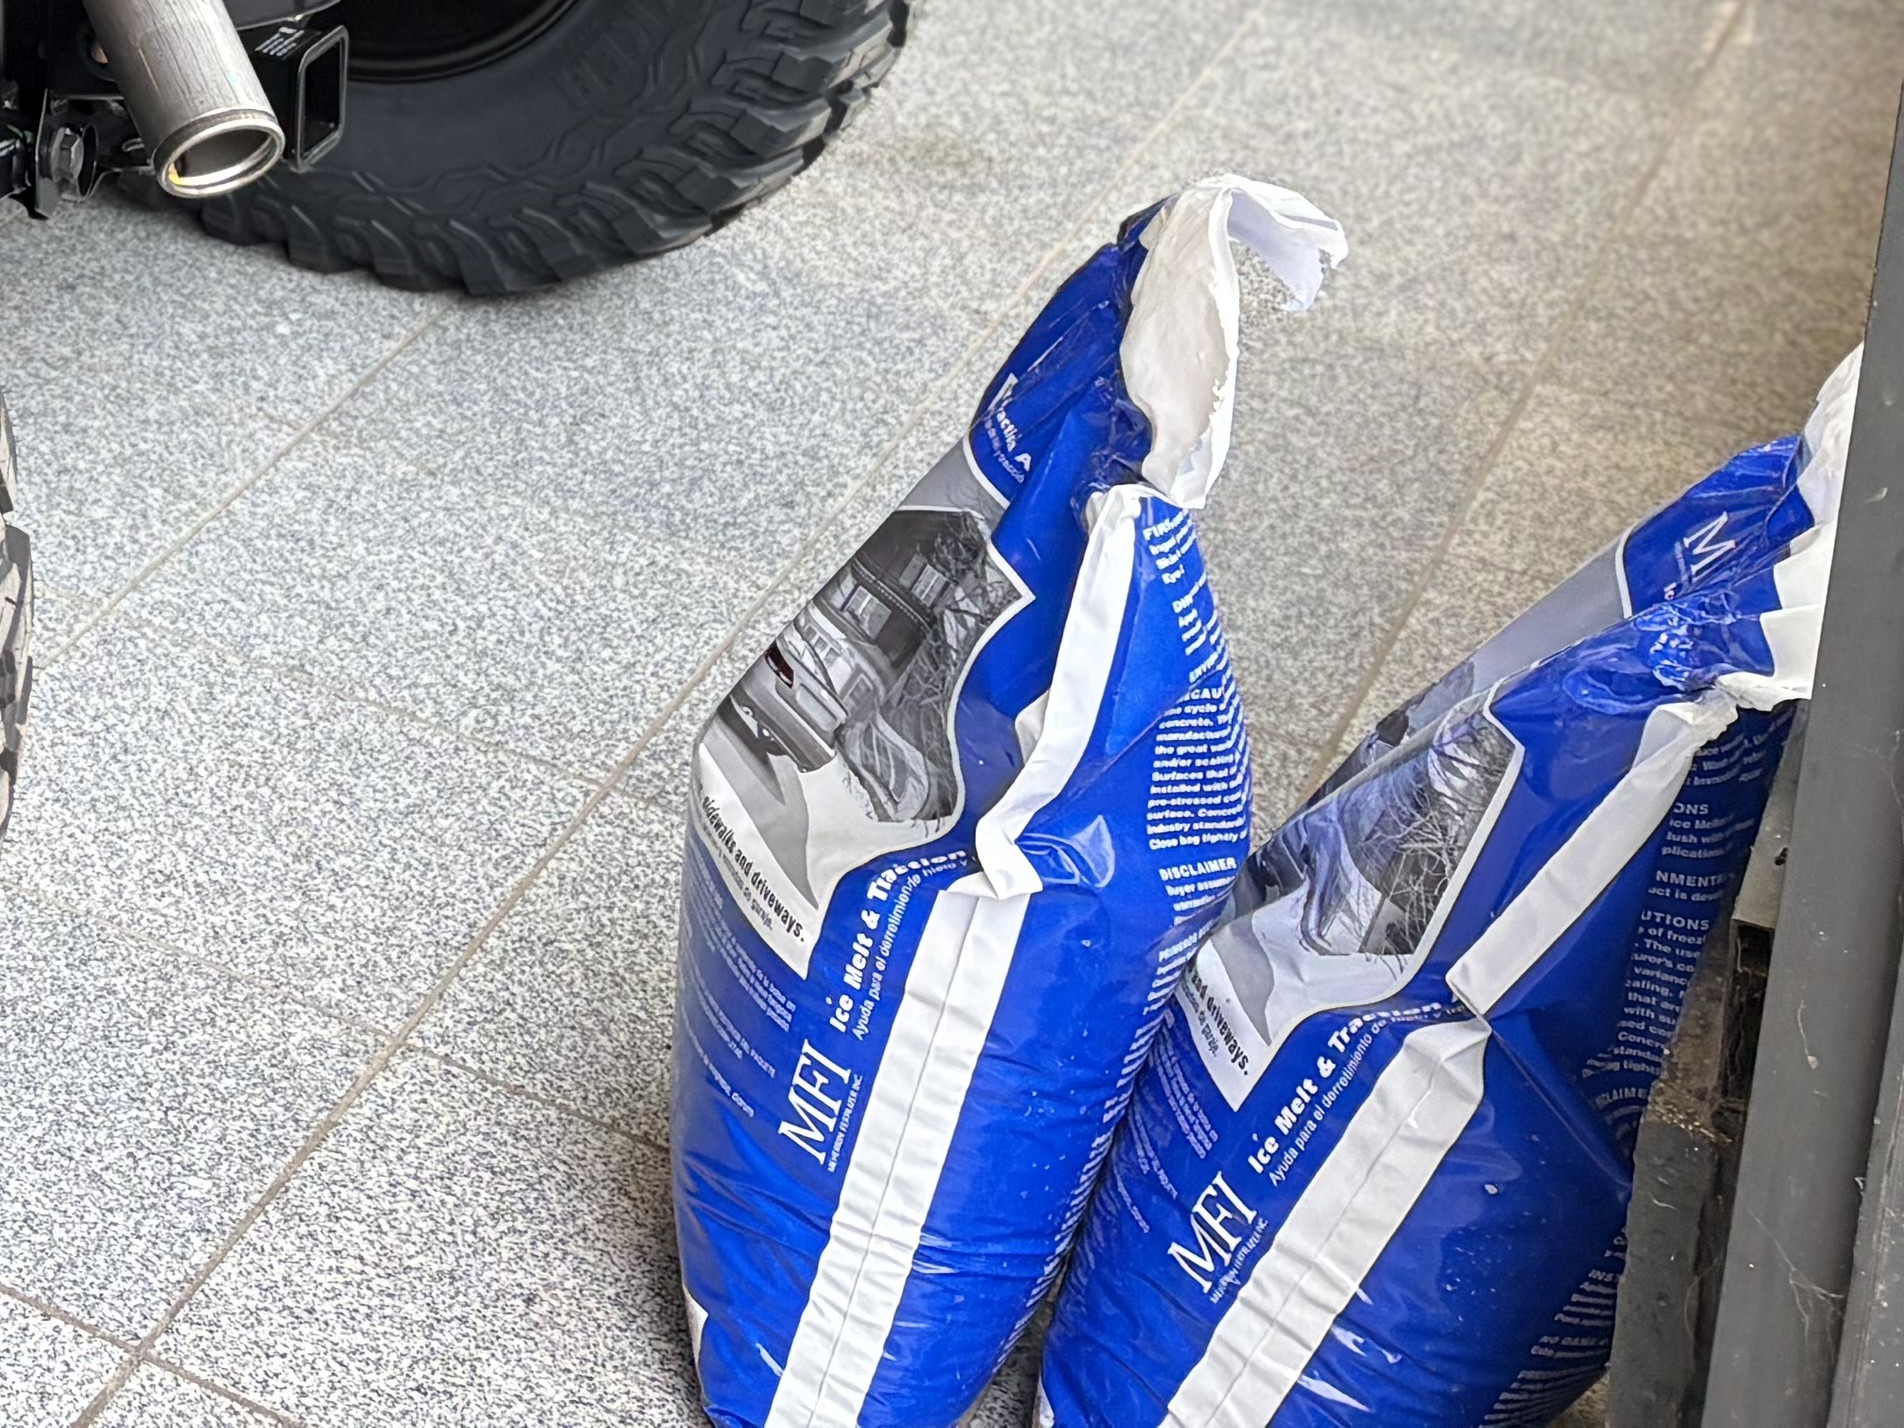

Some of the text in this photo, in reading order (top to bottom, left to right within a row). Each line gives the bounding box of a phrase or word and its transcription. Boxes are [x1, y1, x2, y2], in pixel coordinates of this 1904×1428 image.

[734, 848, 754, 878] and
[750, 870, 805, 943] driveways.
[1159, 857, 1237, 881] DISCLAIMER
[828, 850, 967, 1033] Ice Melt & Traction
[851, 999, 875, 1040] Ayuda
[868, 968, 884, 1002] para
[1206, 996, 1250, 1076] driveways.
[777, 1038, 852, 1166] MFI
[1248, 1002, 1442, 1174] Ice Melt & Traction
[1268, 1146, 1298, 1187] Ayuda
[1294, 1119, 1318, 1152] para
[1167, 1171, 1257, 1293] MFI
